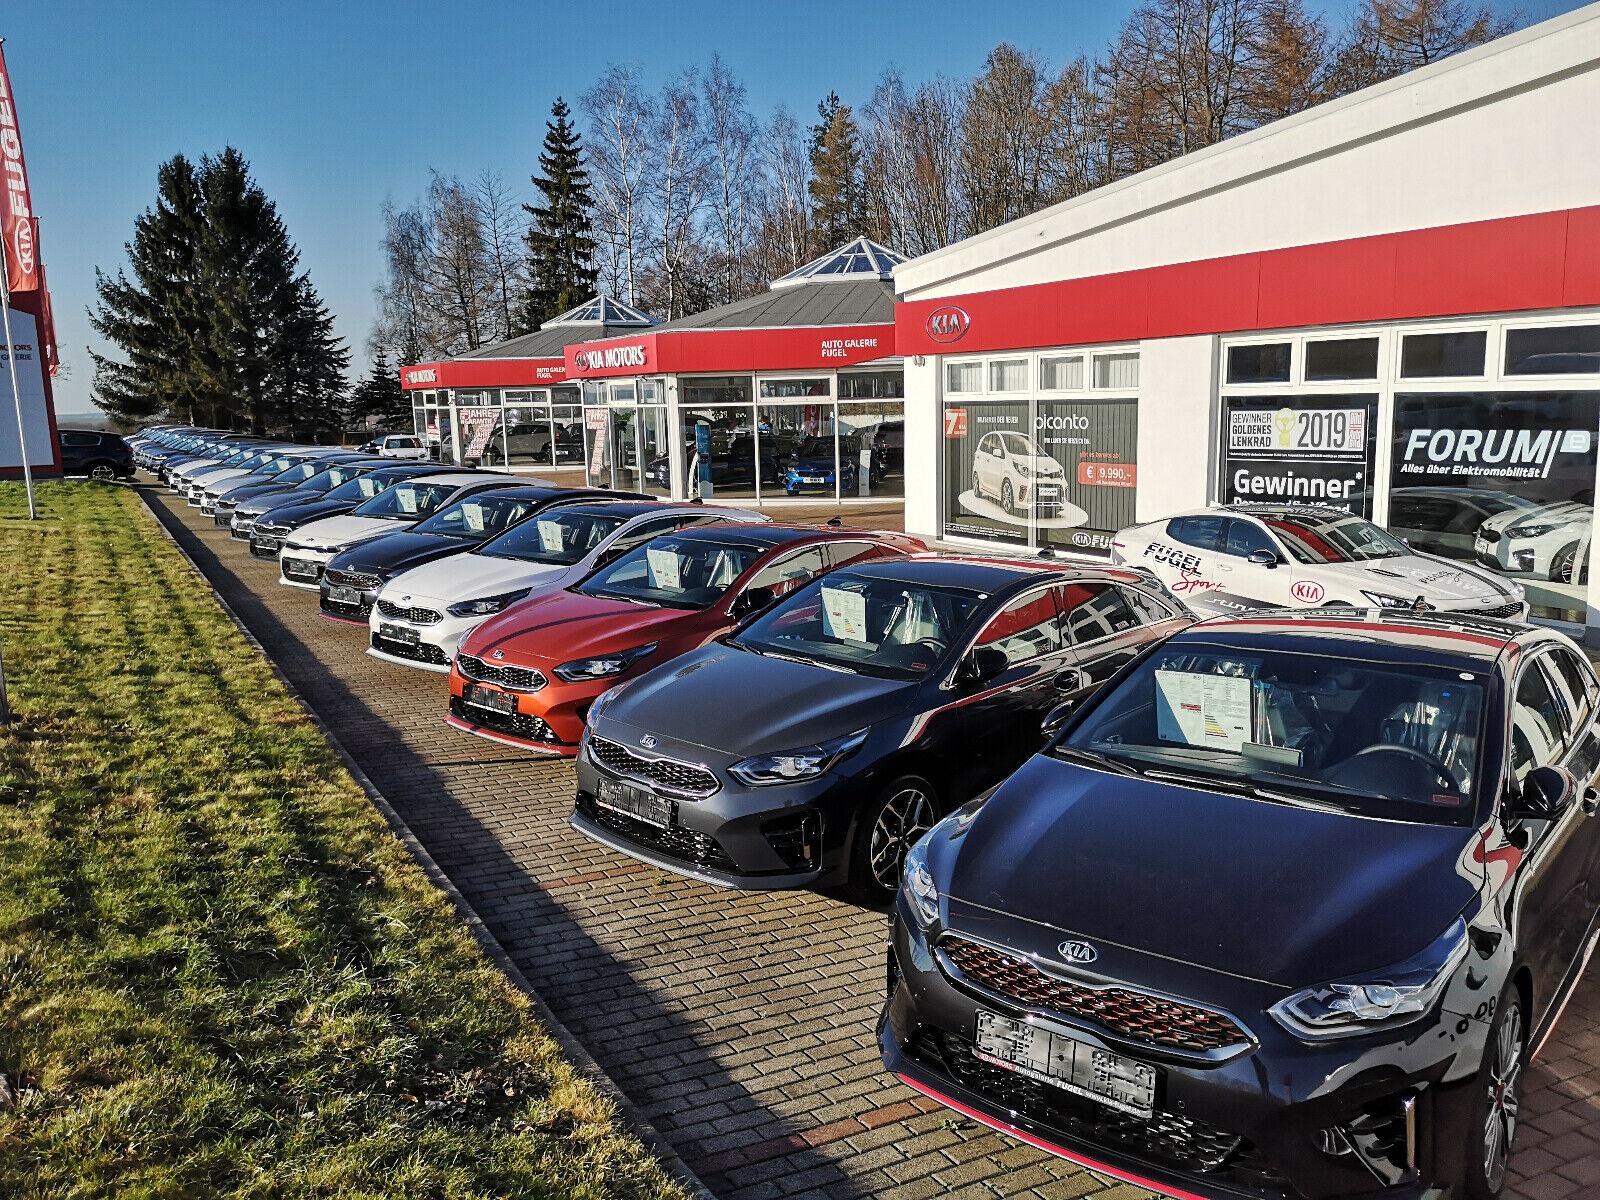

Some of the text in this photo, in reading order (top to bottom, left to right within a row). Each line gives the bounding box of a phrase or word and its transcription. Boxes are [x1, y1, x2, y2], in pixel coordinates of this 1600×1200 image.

[930, 312, 962, 336] KIA
[0, 344, 33, 352] OORS
[821, 338, 878, 349] AUTO GALERIE
[0, 353, 33, 361] GERIE
[586, 345, 646, 369] KIA MOTORS
[821, 348, 848, 358] FUGEL
[468, 409, 493, 418] JAHRE
[1232, 413, 1272, 424] GEWINNER
[945, 412, 959, 435] 7
[1034, 413, 1090, 433] picanto
[1232, 424, 1272, 435] GOLDENES
[1297, 411, 1347, 449] 2019
[1231, 436, 1271, 448] LENKRAD
[1403, 429, 1553, 464] FORUM
[1086, 465, 1094, 479] €
[1400, 464, 1541, 478] Alles über Elektromobilität
[1143, 542, 1202, 577] FUGEL
